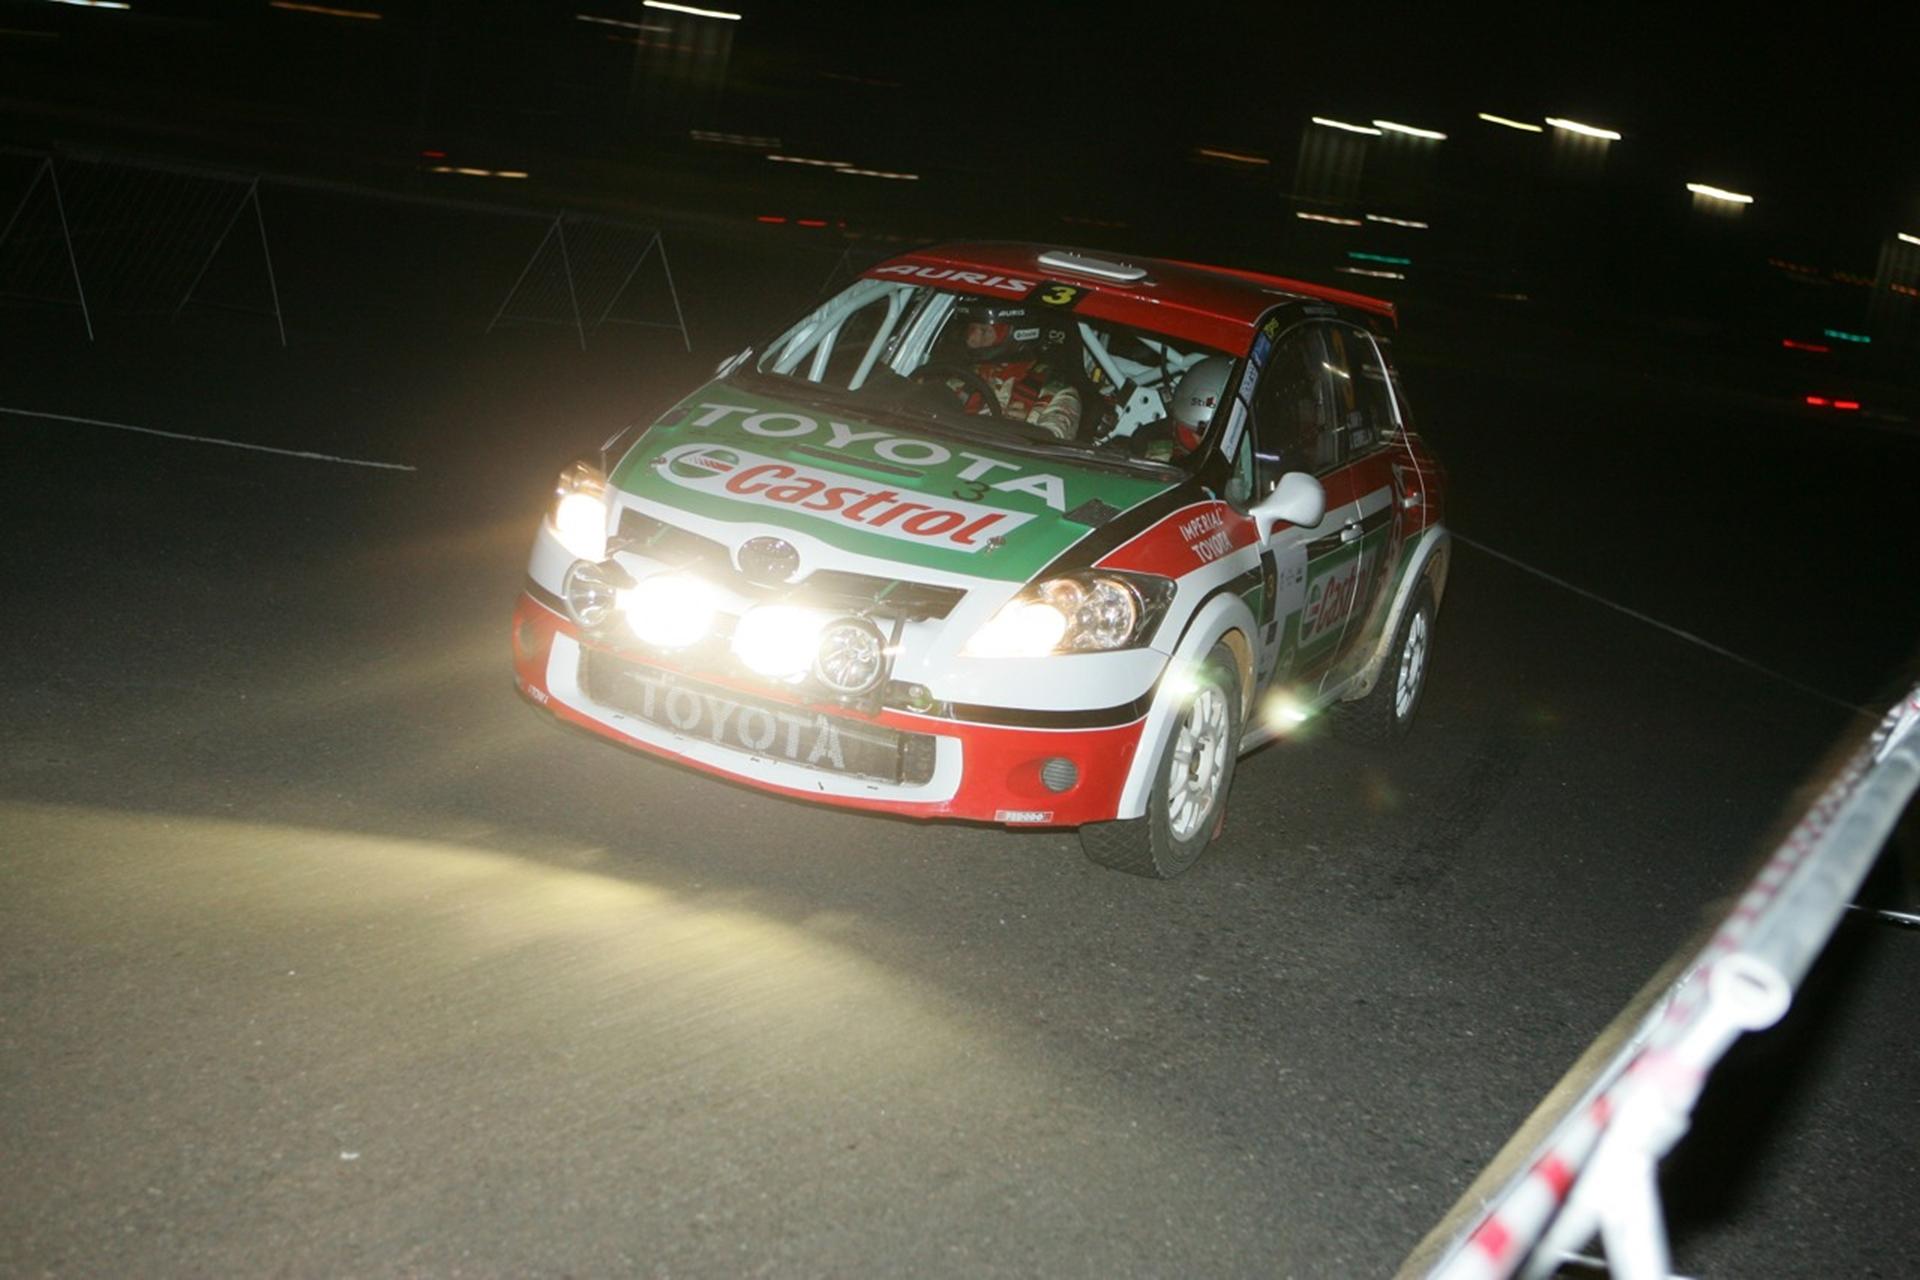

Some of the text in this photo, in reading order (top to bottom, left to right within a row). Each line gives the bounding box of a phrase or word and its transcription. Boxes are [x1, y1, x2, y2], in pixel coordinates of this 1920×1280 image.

[876, 265, 1037, 292] AURIS
[1042, 286, 1077, 305] 3
[692, 403, 1067, 512] TOYOTA
[725, 464, 1008, 545] Castrol
[952, 481, 991, 501] 3
[1179, 507, 1223, 542] IMPERIAL
[1191, 531, 1233, 563] TOYOTA
[624, 673, 845, 768] TOYOTA
